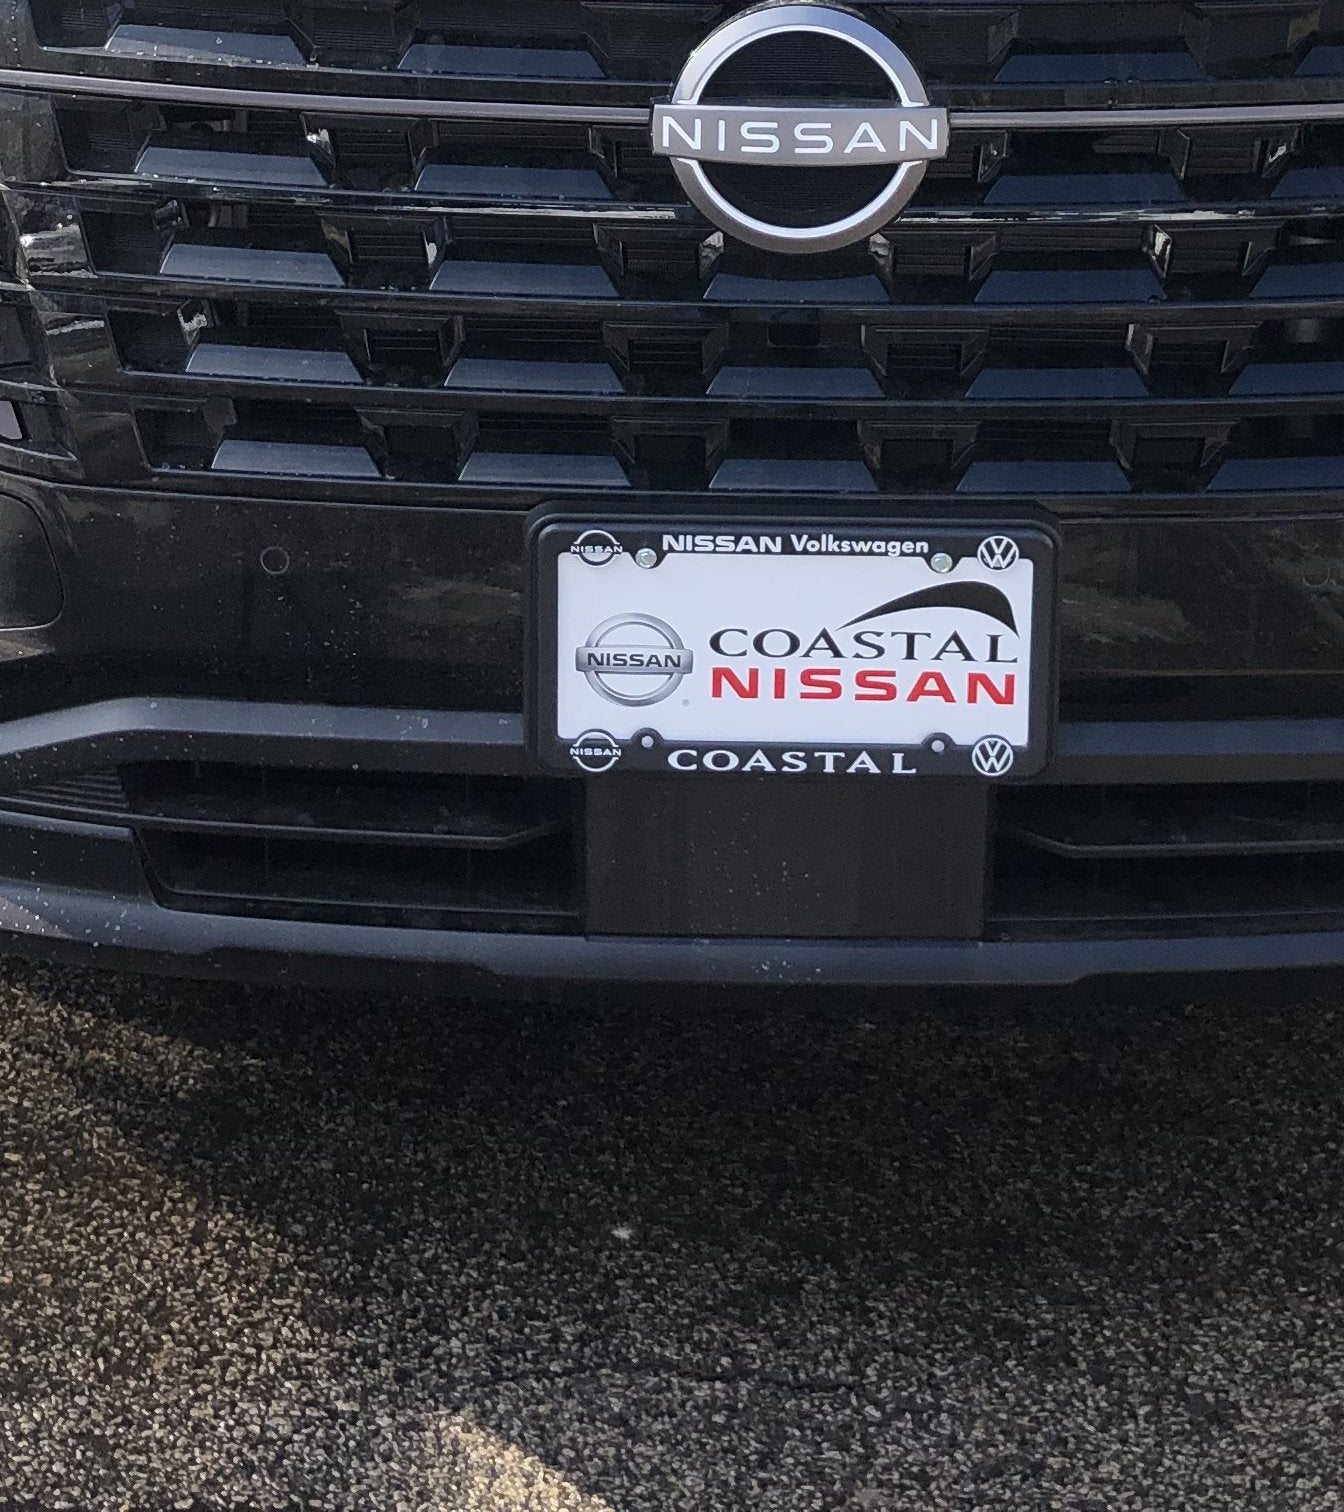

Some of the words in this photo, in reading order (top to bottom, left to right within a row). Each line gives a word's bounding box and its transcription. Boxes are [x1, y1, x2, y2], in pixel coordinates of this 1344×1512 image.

[662, 115, 939, 154] NISSAN
[570, 545, 623, 554] NISSAN
[662, 534, 782, 553] NISSAN
[790, 534, 929, 557] Volkswagen
[709, 626, 1018, 664] COASTAL
[587, 652, 681, 668] NISSAN
[711, 666, 1016, 705] NISSAN
[569, 747, 622, 757] NISSAN
[667, 749, 917, 774] COASTAL
